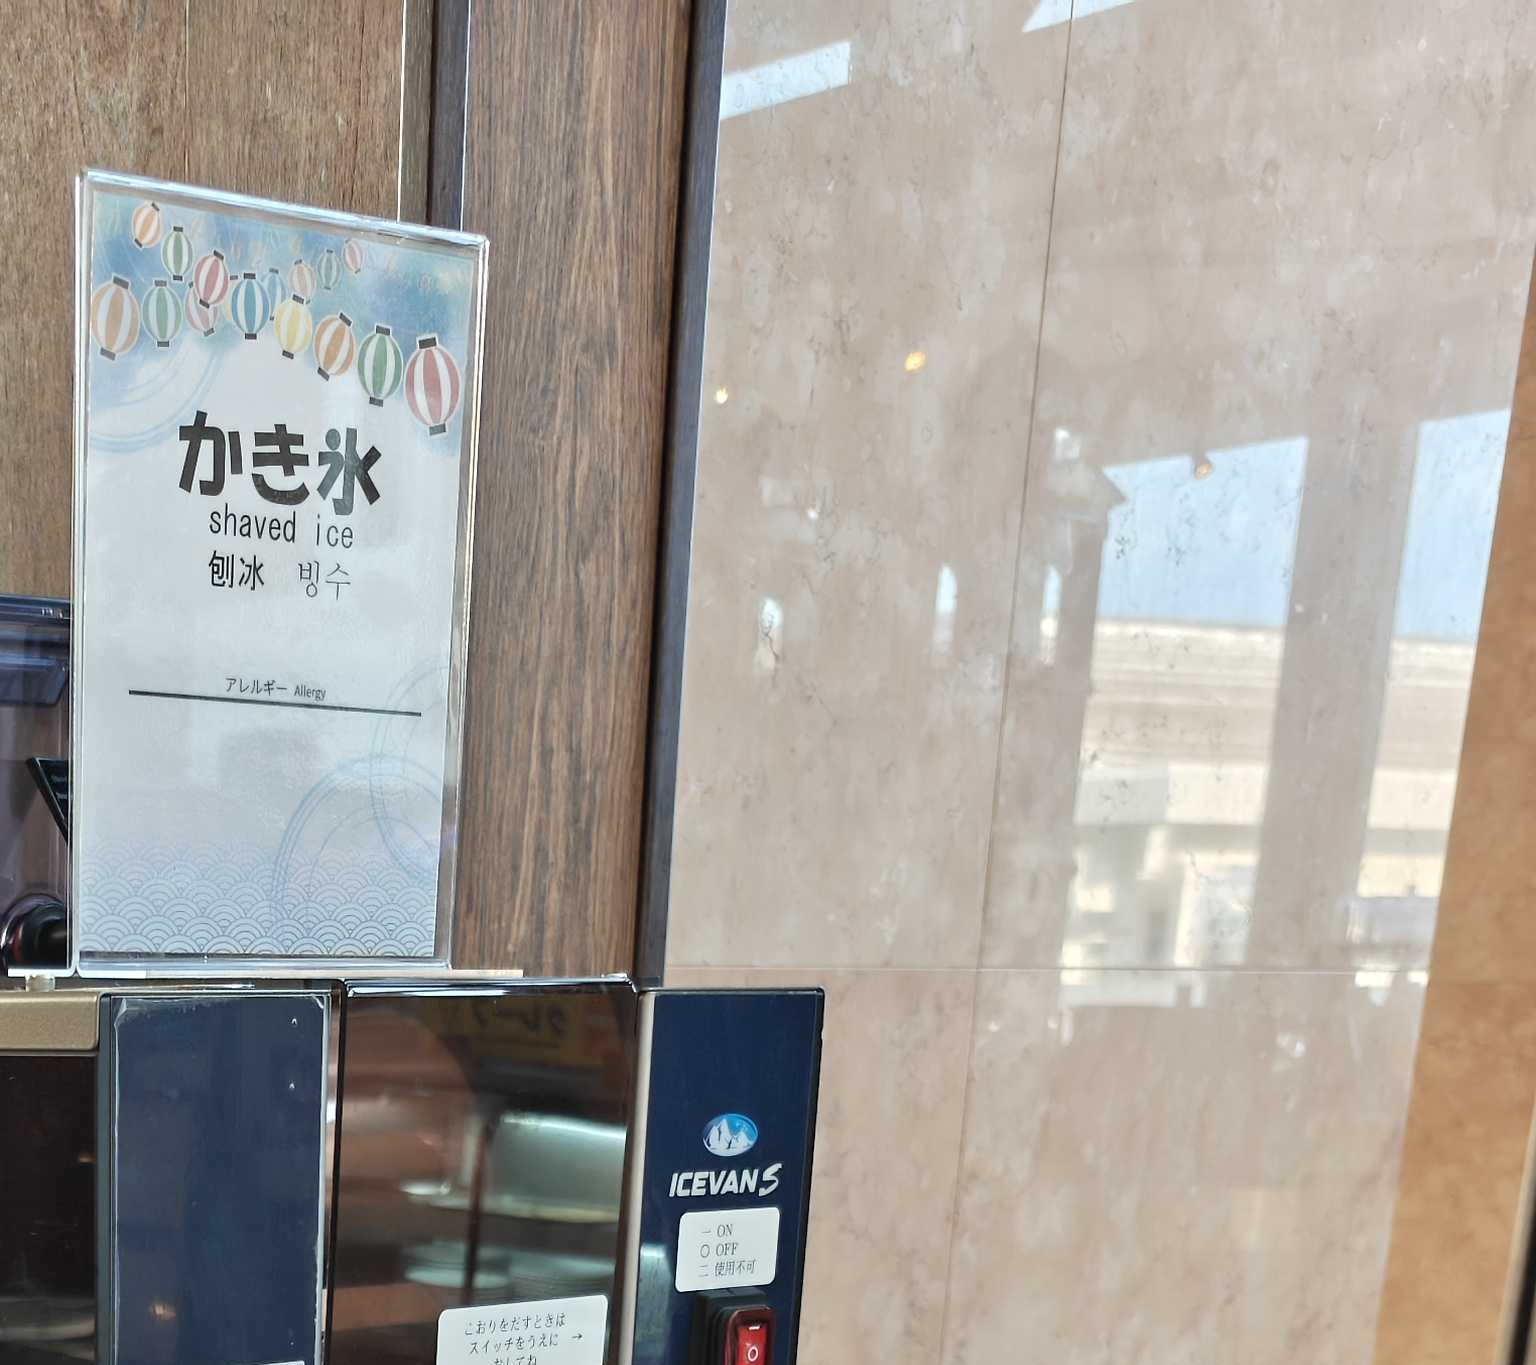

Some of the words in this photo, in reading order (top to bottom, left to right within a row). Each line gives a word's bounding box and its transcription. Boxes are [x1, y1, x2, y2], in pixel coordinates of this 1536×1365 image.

[178, 410, 382, 516] かき氷
[209, 503, 298, 544] shaved
[316, 517, 354, 549] ice
[297, 560, 352, 600] 빙수
[225, 677, 287, 696] アレルギー
[294, 685, 327, 701] Allergy
[717, 1224, 733, 1237] ON
[716, 1242, 739, 1257] OFF
[464, 1312, 566, 1336] こおりをだすときは
[470, 1333, 559, 1355] スイッチをうえに
